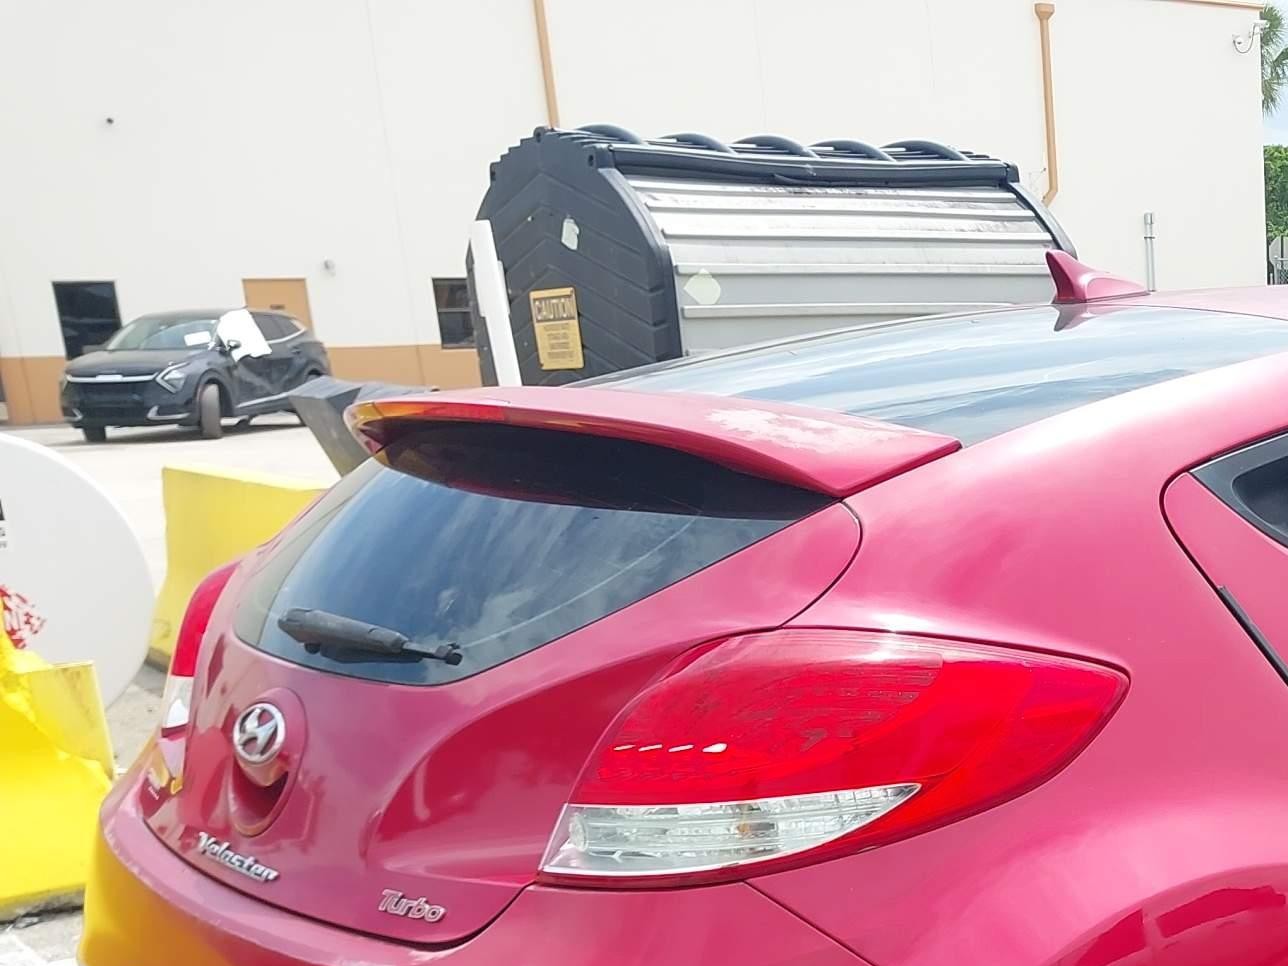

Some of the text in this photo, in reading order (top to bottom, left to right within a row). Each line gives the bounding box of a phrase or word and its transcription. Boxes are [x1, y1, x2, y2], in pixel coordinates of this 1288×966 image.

[535, 297, 576, 320] CAUTION
[197, 831, 280, 882] Veloster
[378, 888, 446, 922] Turbo
